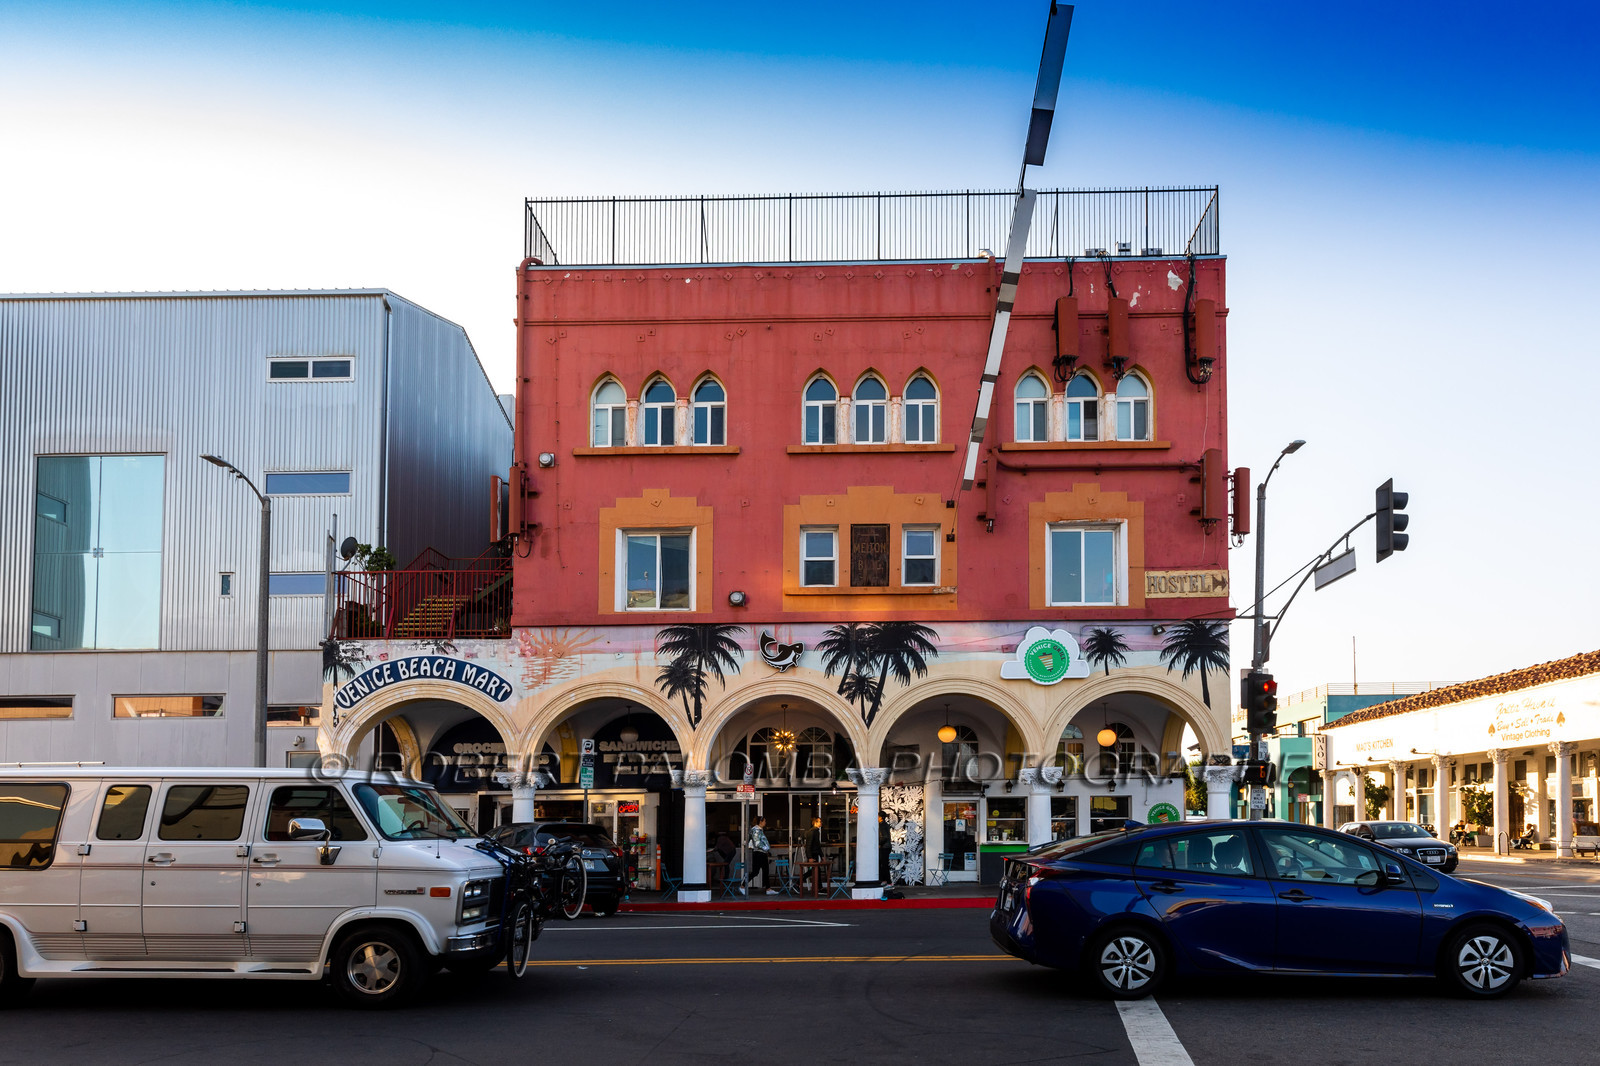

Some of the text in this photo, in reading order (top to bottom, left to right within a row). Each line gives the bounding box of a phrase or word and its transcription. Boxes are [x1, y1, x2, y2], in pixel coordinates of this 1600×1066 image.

[1146, 574, 1211, 593] HOSTEL
[1029, 643, 1066, 661] VENICE GRILL
[337, 657, 511, 707] VENICE BEACH MART
[1501, 728, 1551, 741] Vintage Clothing
[599, 741, 680, 752] SANDWICHE
[1372, 737, 1394, 750] KITCHEN
[618, 804, 640, 814] OPEN
